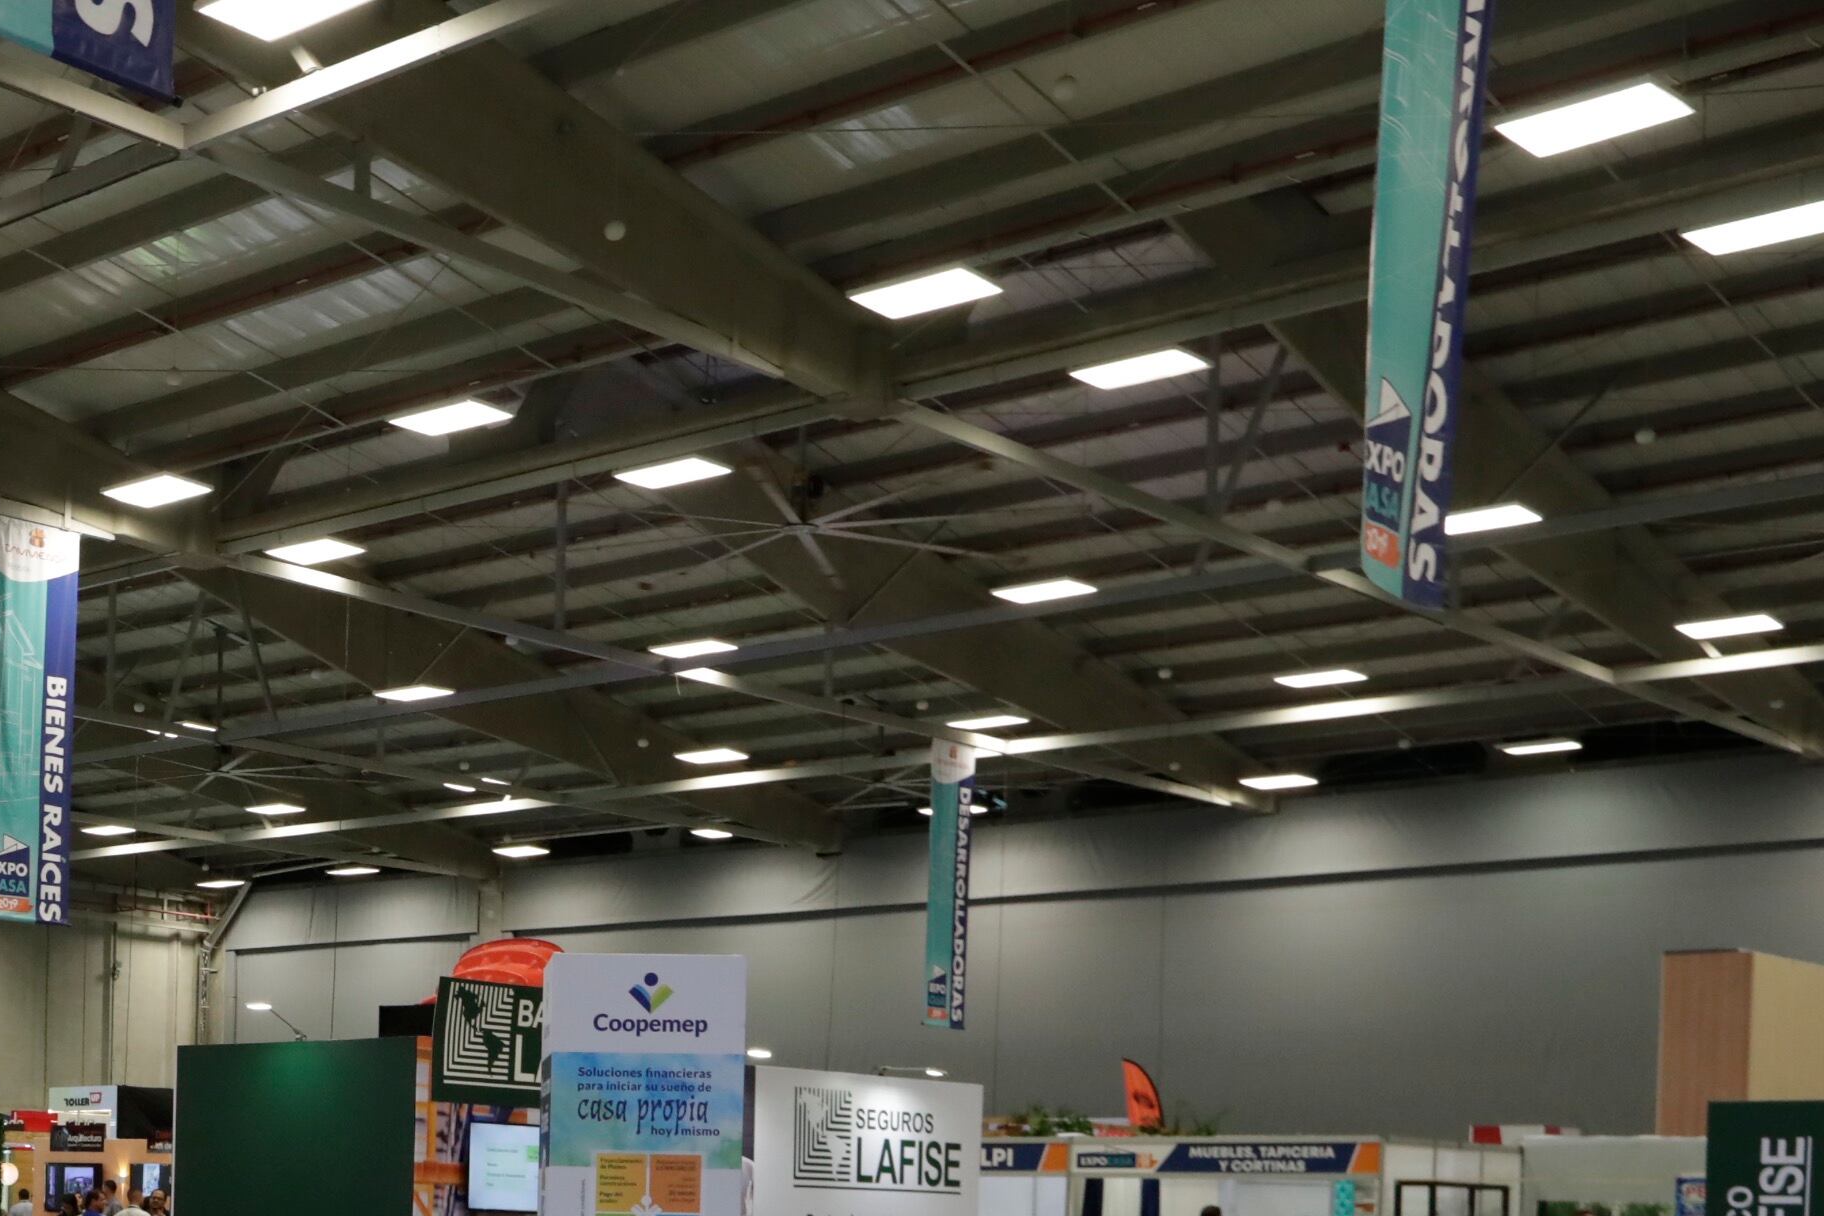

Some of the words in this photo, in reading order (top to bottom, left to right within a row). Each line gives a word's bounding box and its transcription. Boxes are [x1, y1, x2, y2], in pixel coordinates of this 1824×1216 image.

[43, 675, 68, 794] BIENES
[39, 804, 66, 922] RAÍCES
[951, 787, 973, 1022] DESARROLLADORAS
[592, 1013, 708, 1037] Coopemep
[577, 1066, 642, 1078] Soluciones
[646, 1067, 712, 1079] financieras
[577, 1083, 603, 1092] para
[606, 1080, 641, 1092] iniciar
[645, 1083, 658, 1092] su
[661, 1081, 695, 1093] sueño
[698, 1081, 712, 1093] de
[577, 1098, 628, 1122] casa
[636, 1095, 708, 1136] propia
[855, 1108, 934, 1134] SEGUROS
[651, 1125, 673, 1138] hoy
[681, 1126, 720, 1137] mismo
[856, 1136, 962, 1188] LAFISE
[1188, 1145, 1257, 1159] MUEBLES,
[1258, 1145, 1336, 1159] TAPICERIA
[1218, 1159, 1229, 1172] Y
[1230, 1159, 1306, 1173] CORTINAS
